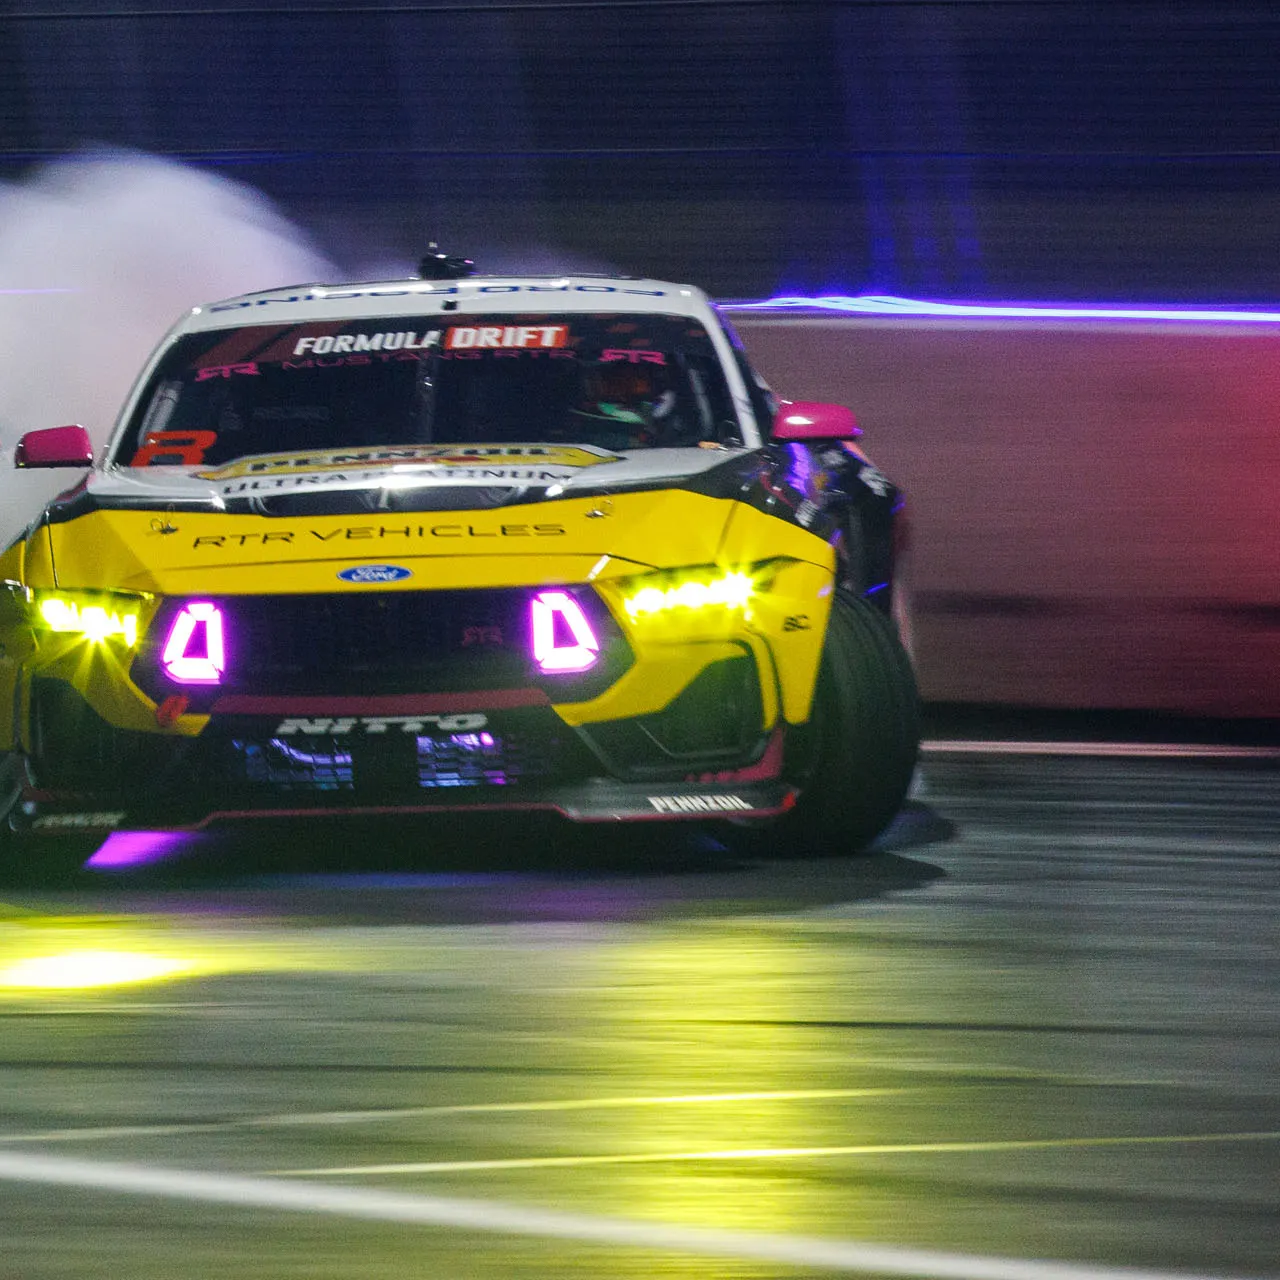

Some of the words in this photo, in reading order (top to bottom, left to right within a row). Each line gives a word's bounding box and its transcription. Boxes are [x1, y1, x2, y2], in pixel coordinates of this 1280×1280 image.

[293, 329, 443, 356] FORMULA
[450, 325, 564, 349] DRIFT
[223, 472, 349, 495] ULTRA
[192, 531, 294, 551] RTR
[310, 523, 567, 542] VEHICLES
[275, 713, 489, 735] NITTO
